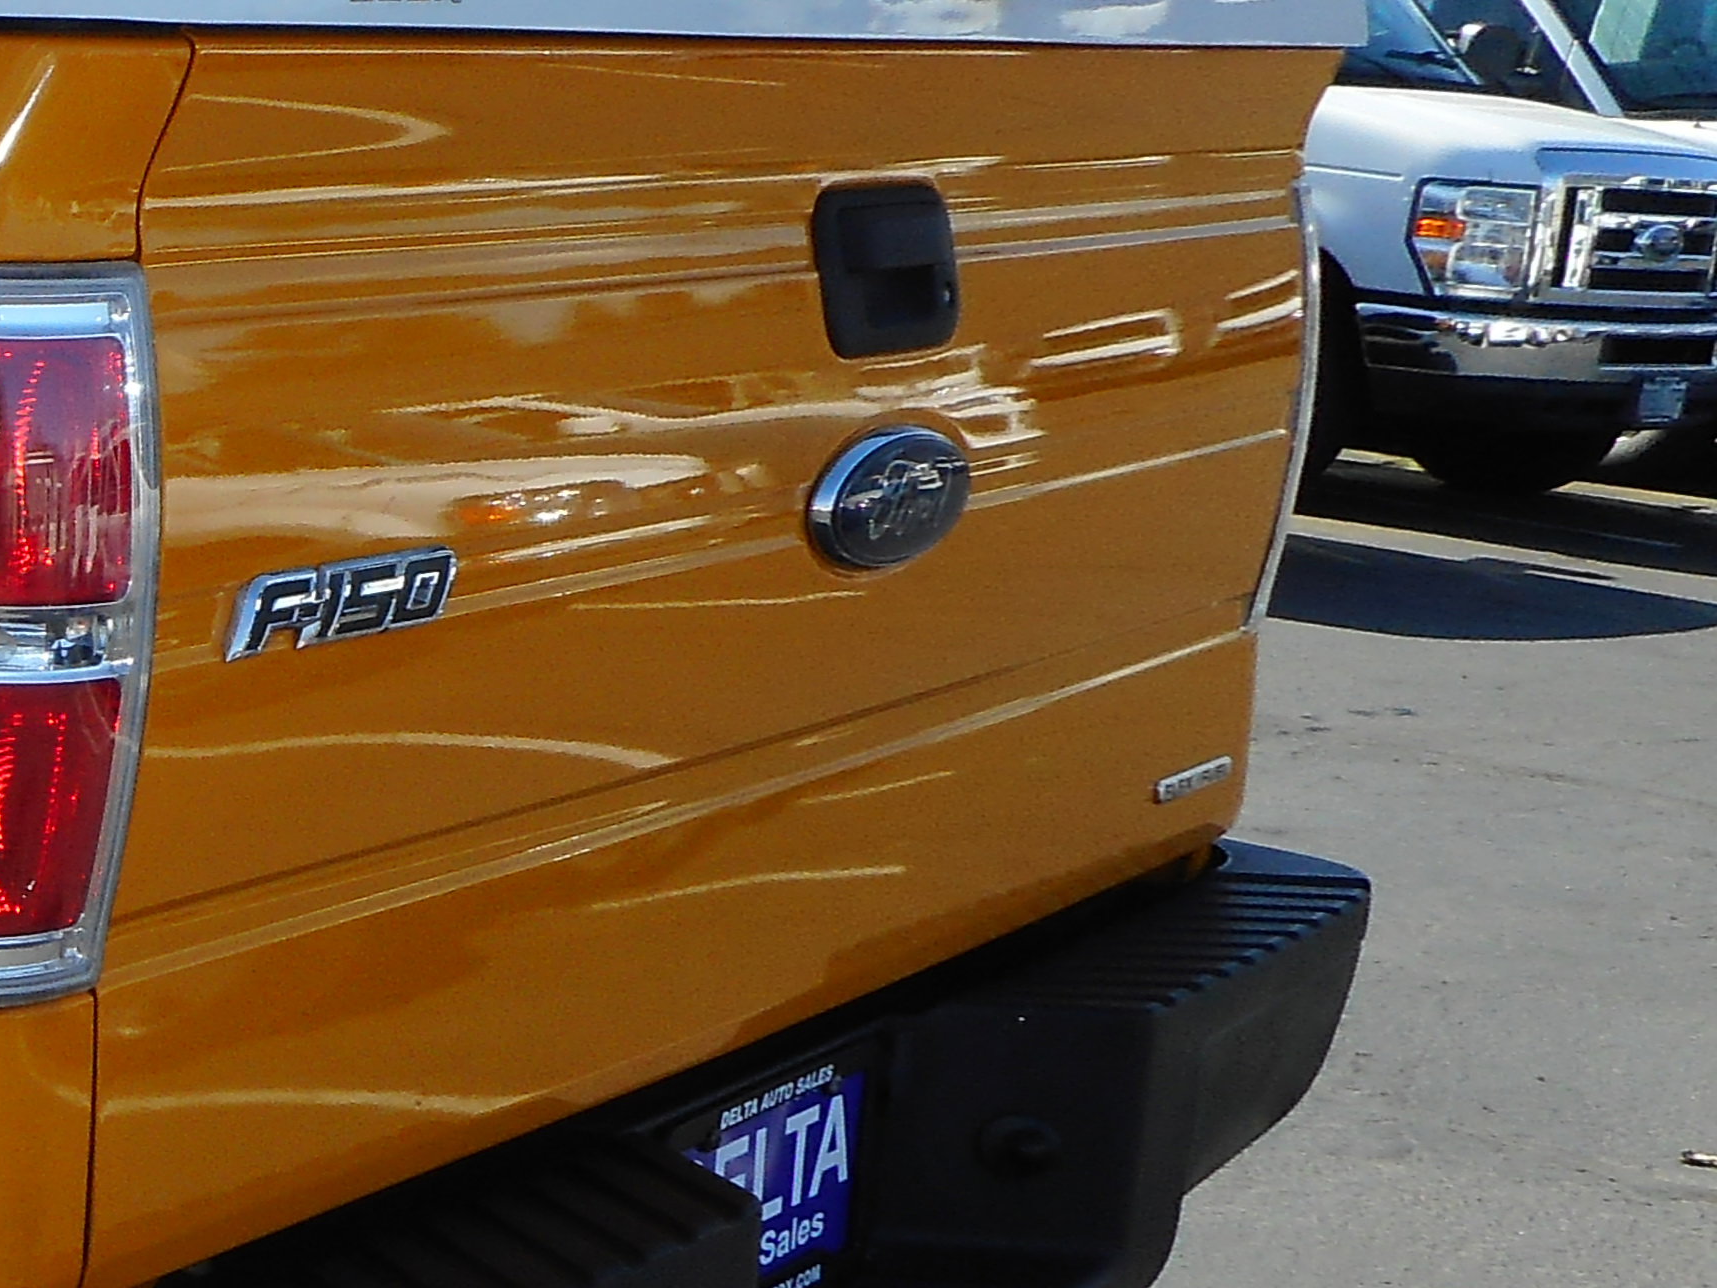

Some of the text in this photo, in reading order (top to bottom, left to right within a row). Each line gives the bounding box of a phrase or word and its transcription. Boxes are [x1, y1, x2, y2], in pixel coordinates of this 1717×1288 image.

[225, 544, 458, 663] F-150
[719, 1063, 835, 1131] DELTA AUTO SALES
[759, 1212, 825, 1266] Sales
